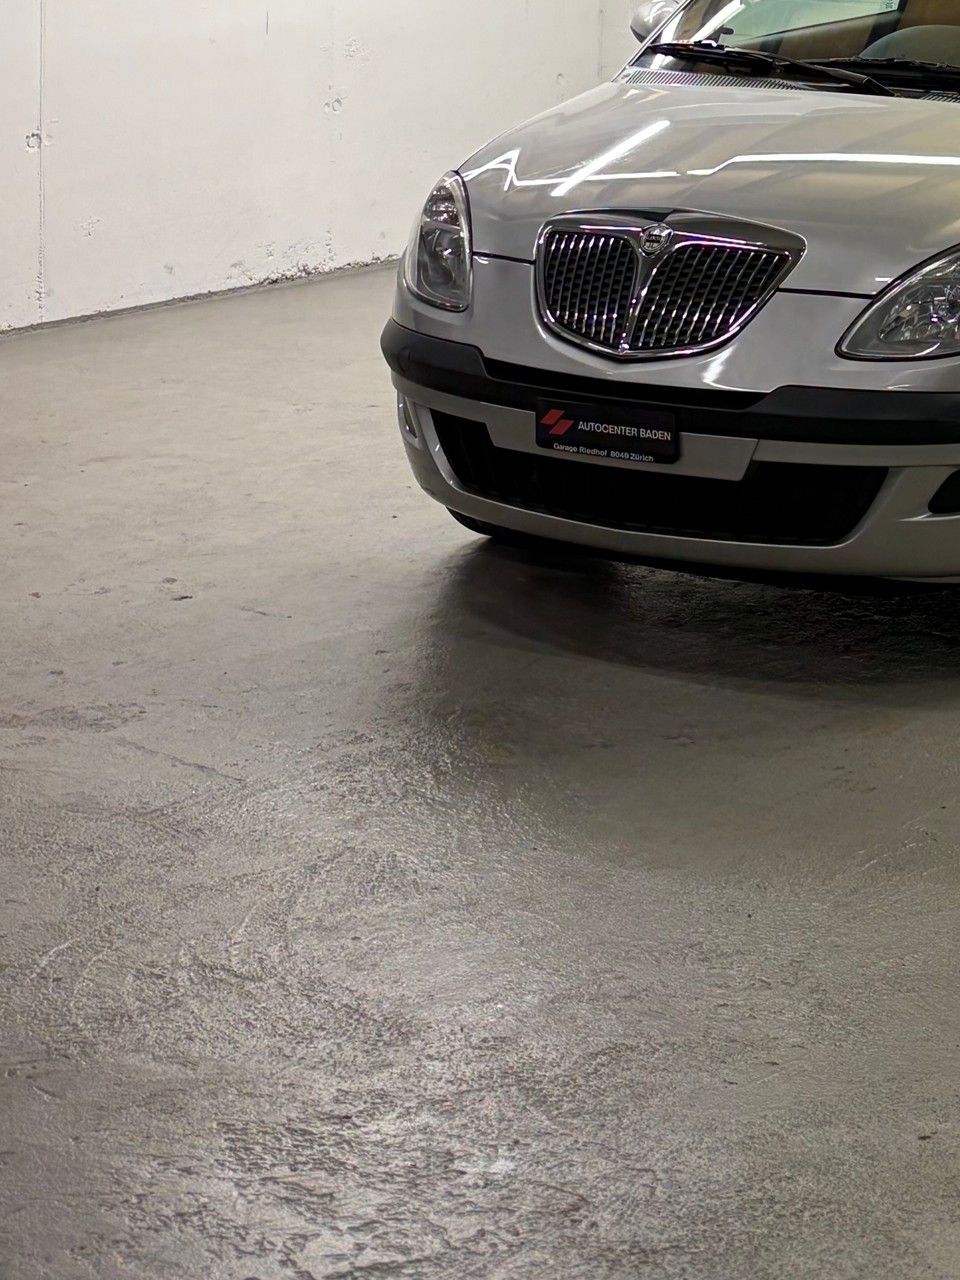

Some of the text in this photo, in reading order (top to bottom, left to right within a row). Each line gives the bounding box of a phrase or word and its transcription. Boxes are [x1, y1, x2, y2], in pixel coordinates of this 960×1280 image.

[578, 421, 671, 441] AUTOCENTER BADEN
[553, 442, 654, 462] Garage Riedhof 8049 Zürich
